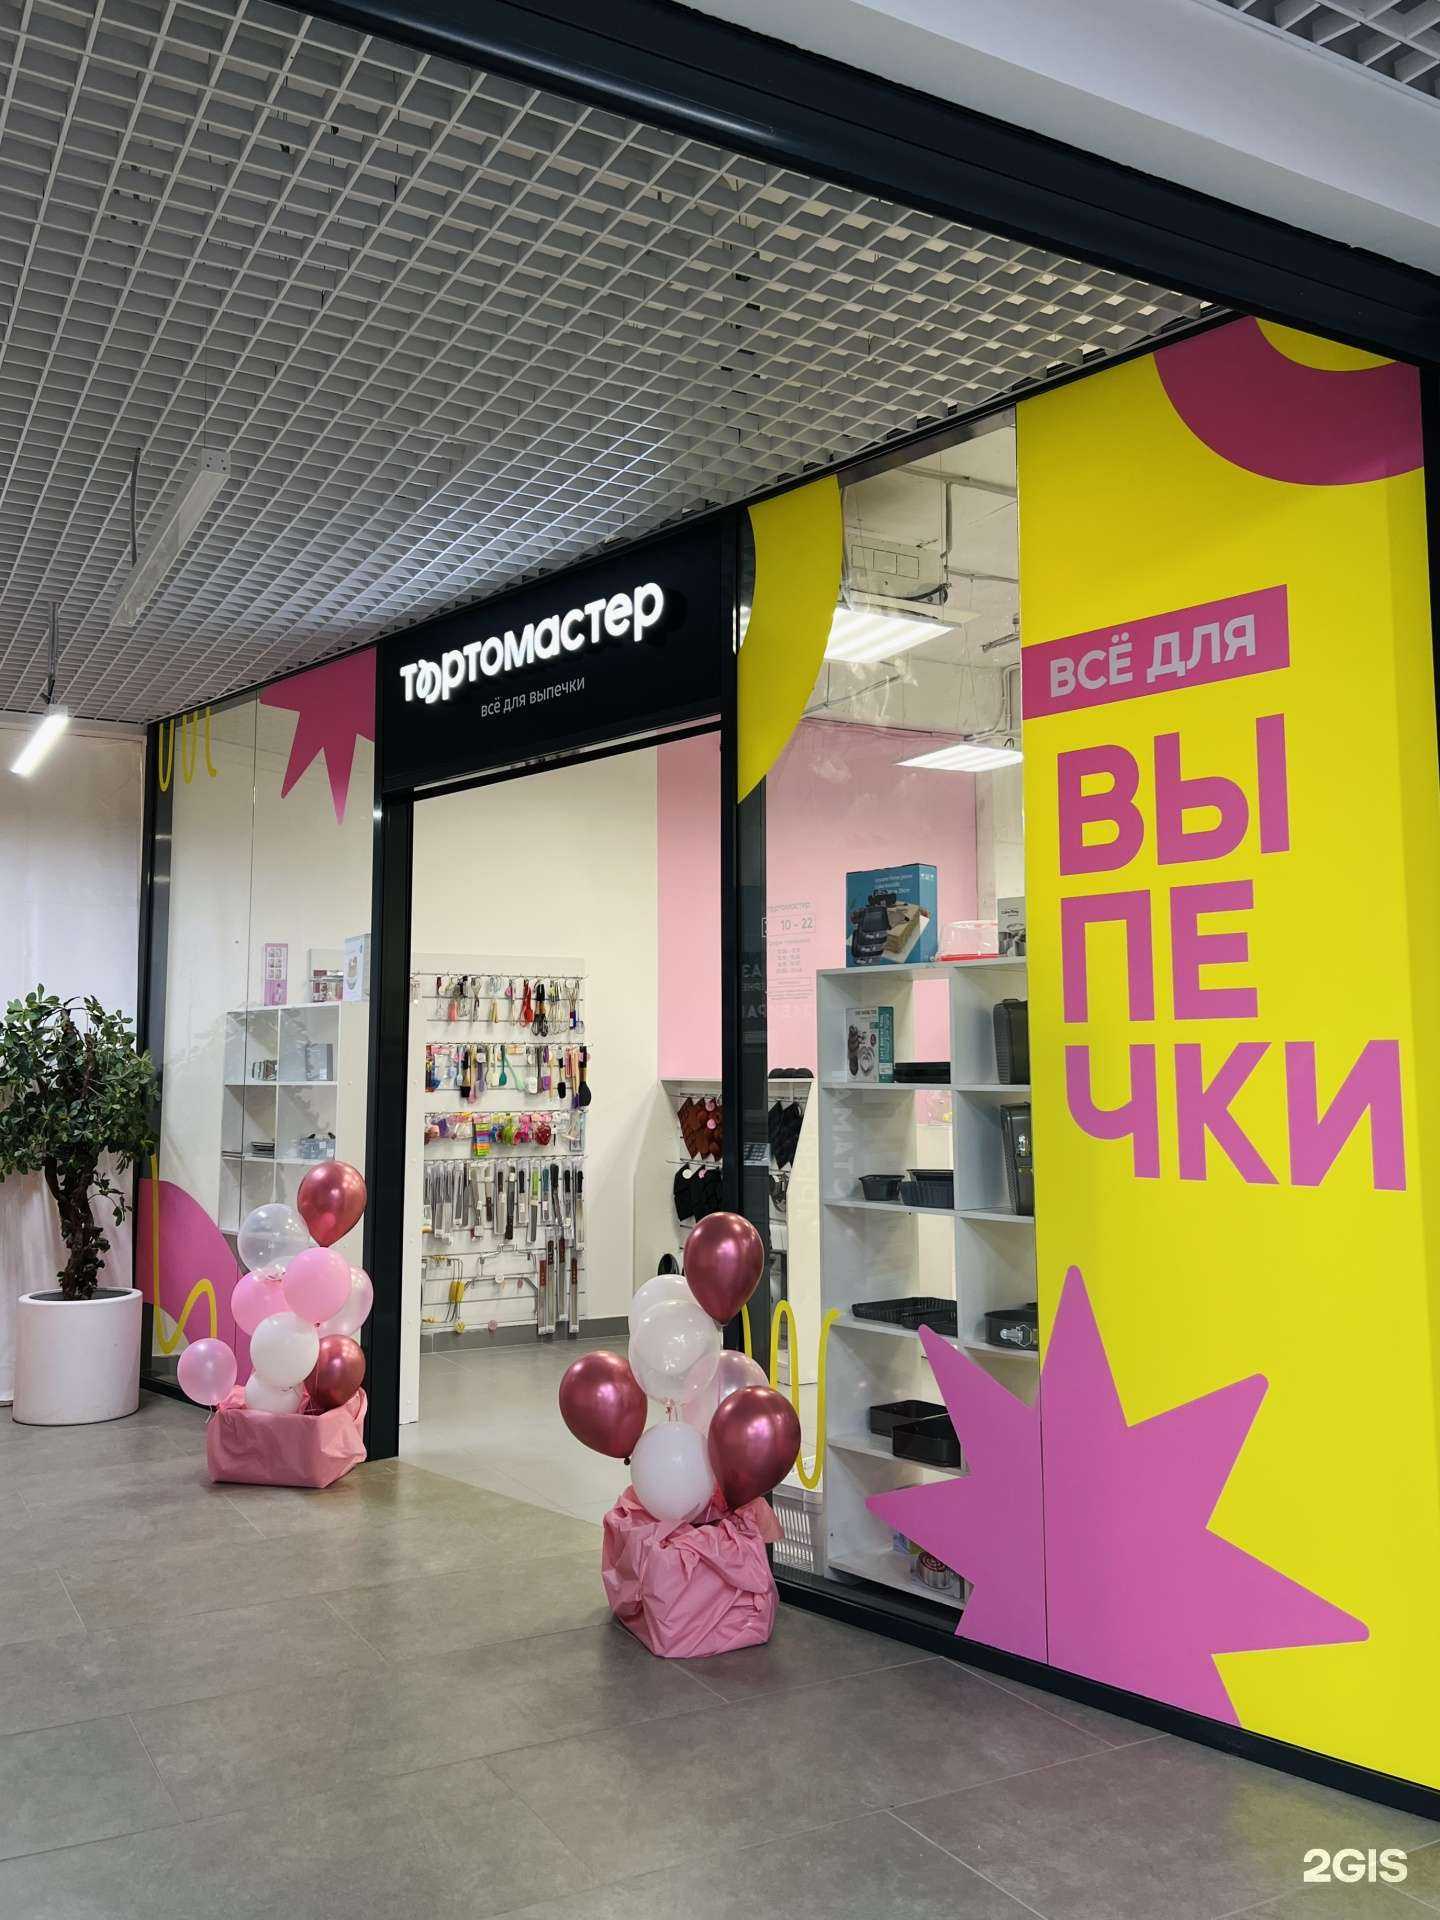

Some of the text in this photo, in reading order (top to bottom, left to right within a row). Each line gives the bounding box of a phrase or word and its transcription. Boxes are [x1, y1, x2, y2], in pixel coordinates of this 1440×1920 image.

[481, 677, 585, 717] всё для выпечки
[1050, 614, 1256, 697] ВСЁ ДЛЯ
[1057, 713, 1289, 876] ВЫ
[780, 919, 792, 931] 10
[801, 917, 813, 929] 22
[1061, 880, 1258, 1023] ПЕ
[1065, 1040, 1406, 1191] ЧКИ
